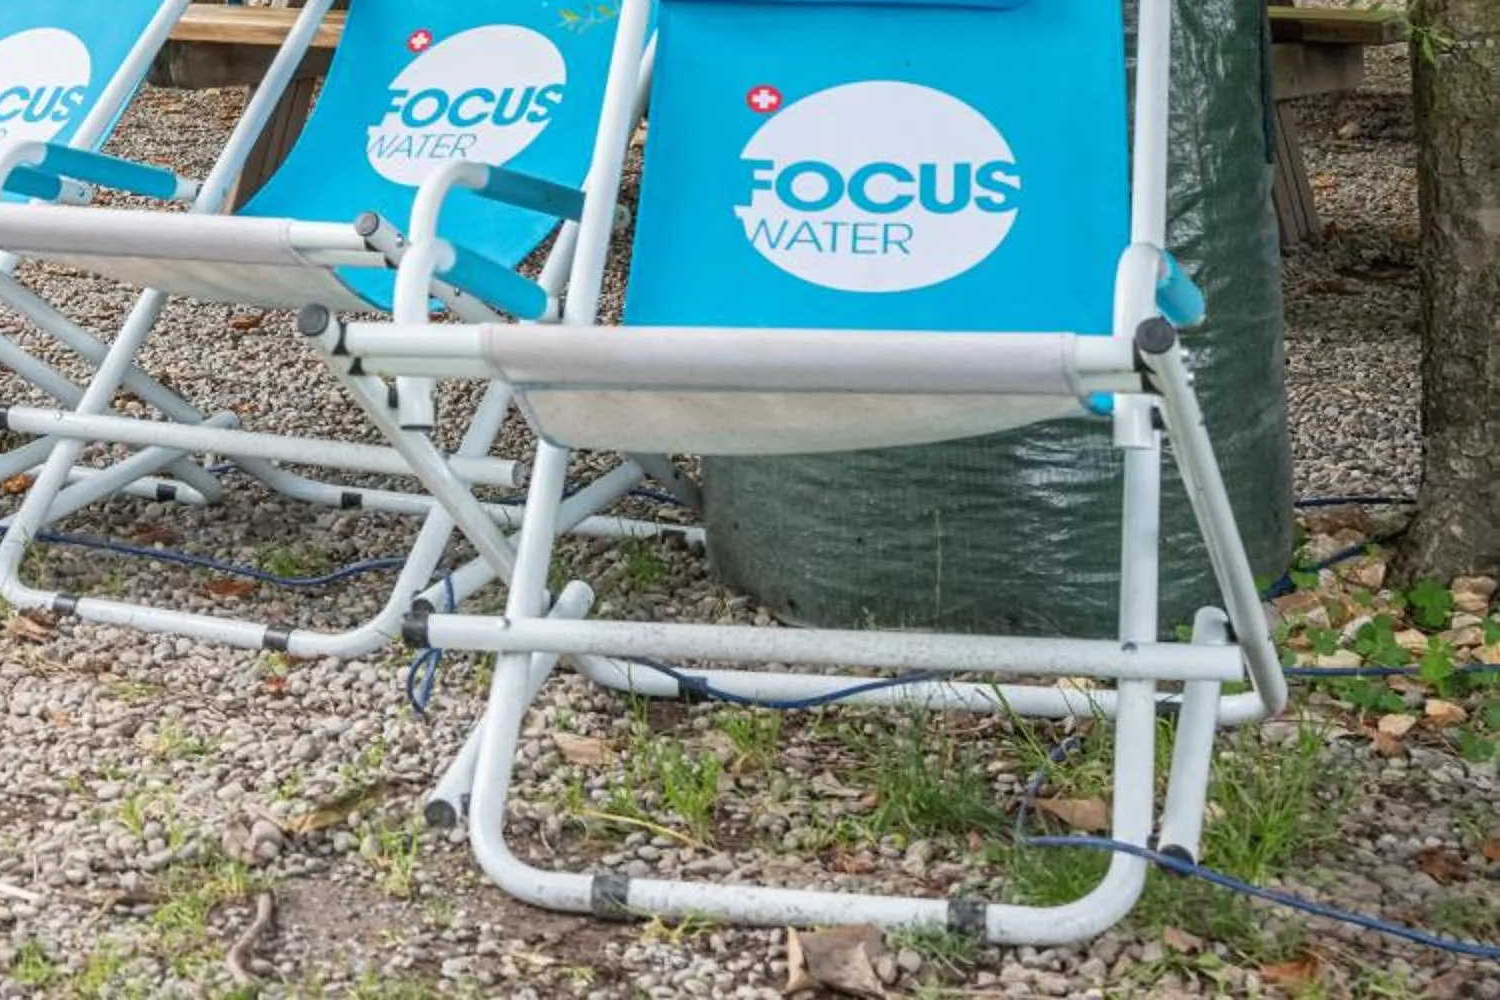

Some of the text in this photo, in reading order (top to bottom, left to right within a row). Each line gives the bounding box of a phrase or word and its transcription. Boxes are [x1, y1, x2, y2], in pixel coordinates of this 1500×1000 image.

[370, 83, 565, 128] FOCUS
[736, 158, 1021, 214] FOCUS
[747, 218, 914, 256] WATER
